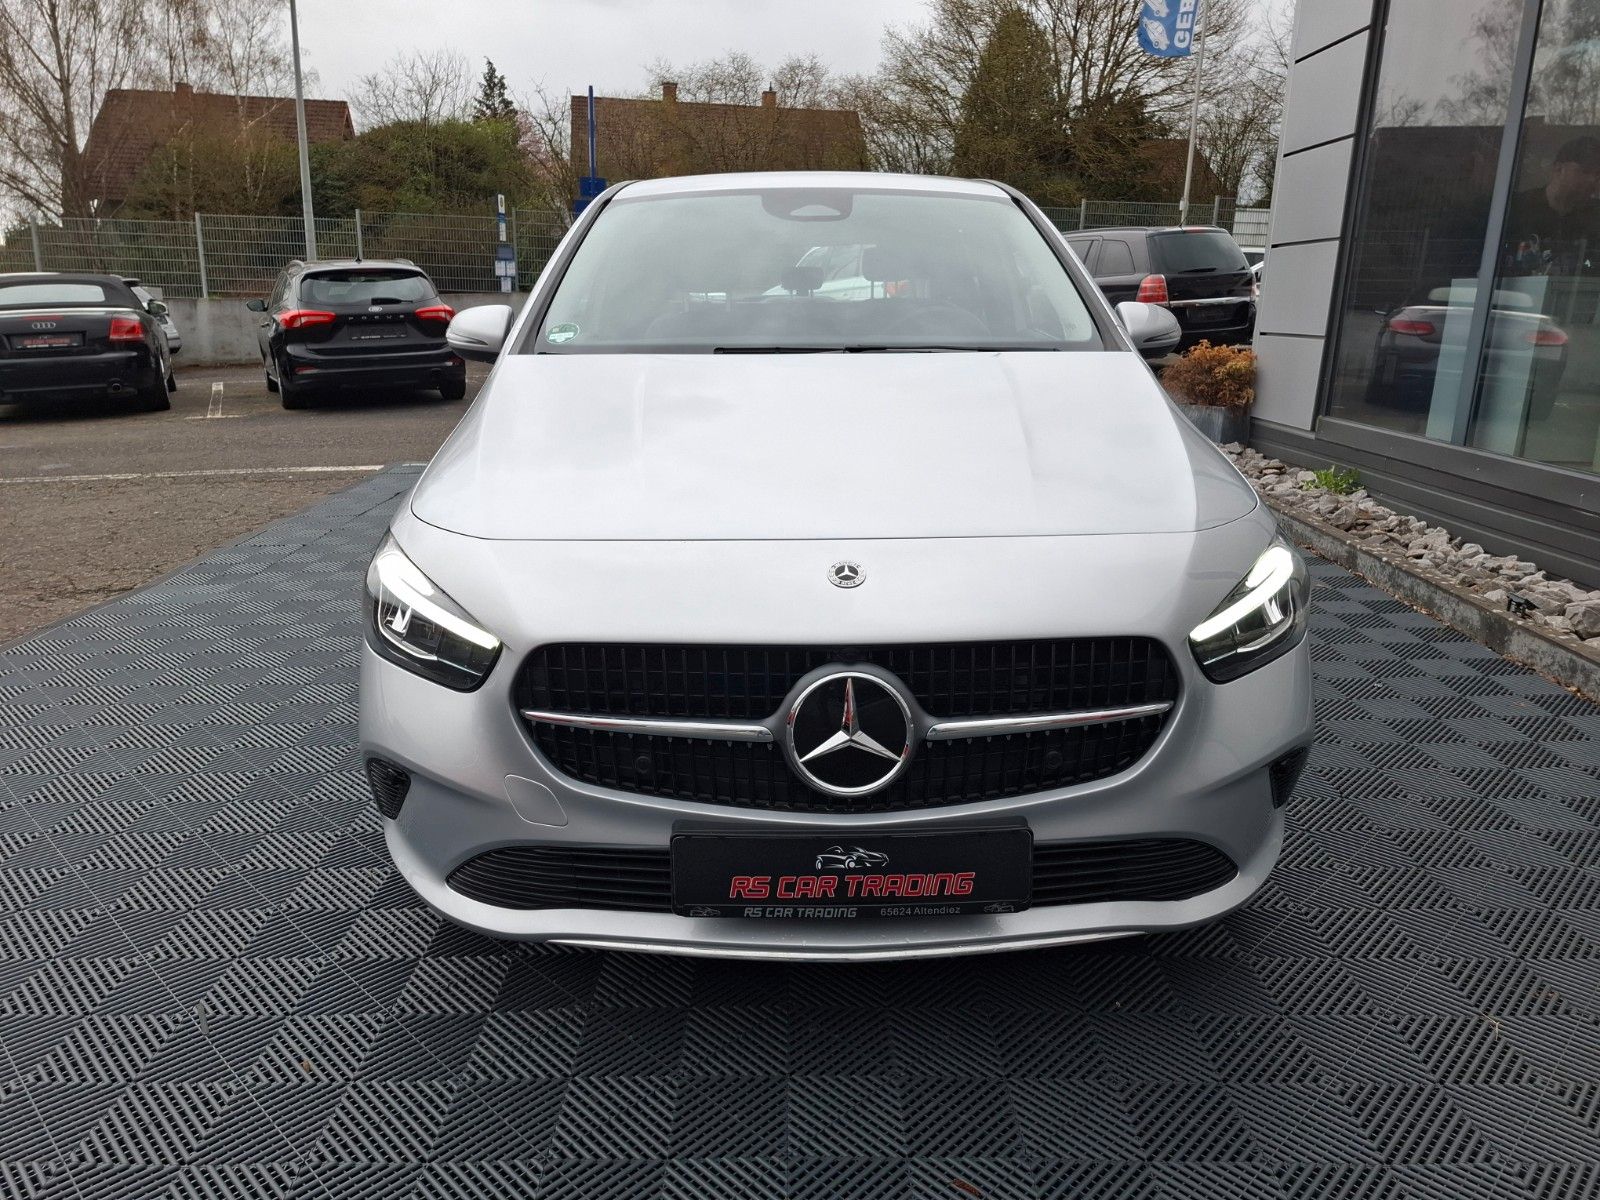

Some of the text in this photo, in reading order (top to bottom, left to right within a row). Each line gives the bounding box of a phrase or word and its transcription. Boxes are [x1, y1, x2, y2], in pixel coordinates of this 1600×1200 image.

[729, 872, 976, 899] RS CAR TRADING
[743, 907, 858, 918] RS CAR TRADING
[880, 902, 961, 916] 65624 Altendiez
